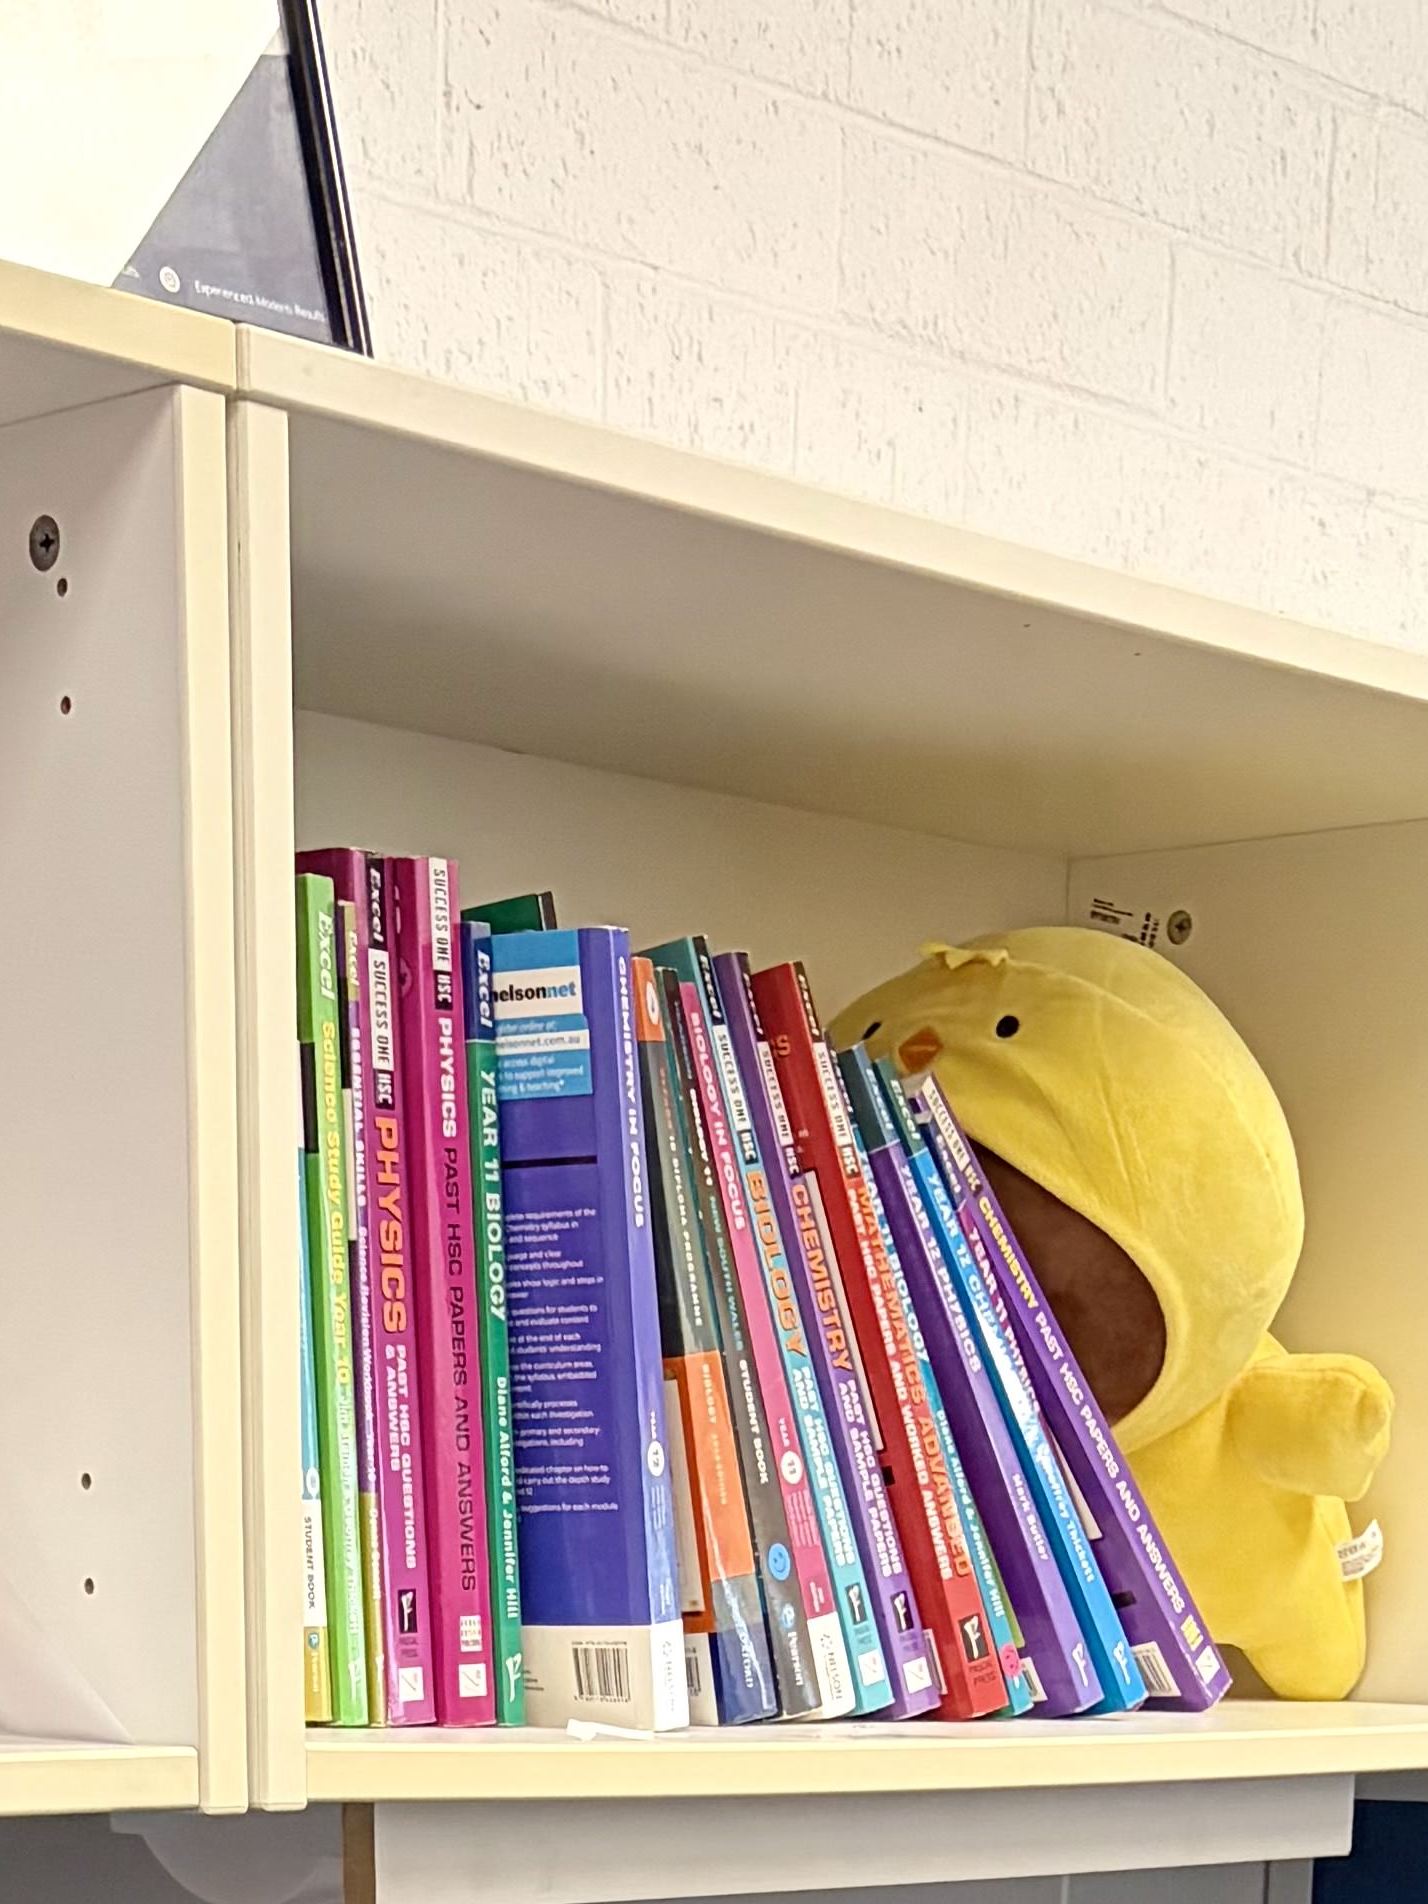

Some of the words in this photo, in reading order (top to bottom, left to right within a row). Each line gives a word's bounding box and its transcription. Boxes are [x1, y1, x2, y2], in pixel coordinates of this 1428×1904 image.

[370, 869, 384, 943] Excel
[433, 869, 448, 937] SUCCESS
[436, 941, 449, 962] ONE
[317, 911, 335, 1000] Excel
[374, 961, 388, 1029] SUCCESS
[477, 950, 493, 1029] Excel
[377, 1034, 390, 1063] ONE
[438, 1017, 456, 1139] PHYSICS
[618, 956, 636, 1102] CHEMISTRY
[480, 1070, 498, 1147] YEAR
[628, 1107, 638, 1136] IN
[690, 1012, 721, 1116] BIOLOGY
[714, 1121, 727, 1146] IN
[721, 1151, 746, 1231] FOCUS
[699, 955, 721, 1019] Excel
[746, 1171, 807, 1357] BIOLOGY
[890, 1080, 921, 1140] Excel
[926, 1173, 958, 1238] YEAR
[443, 1147, 460, 1215] PAST
[630, 1141, 644, 1228] FOCUS
[743, 973, 763, 1035] Excel
[792, 1185, 853, 1372] CHEMISTRY
[866, 1068, 894, 1131] Excel
[901, 1164, 929, 1230] YEAR
[939, 1268, 982, 1374] PHYSICS
[375, 1117, 407, 1334] PHYSICS
[447, 1223, 463, 1276] HSC
[485, 1192, 507, 1322] BIOLOGY
[799, 975, 820, 1036] Excel
[857, 1187, 923, 1407] MATHEMATICS
[918, 1415, 972, 1577] ADVANCED
[396, 1344, 409, 1398] PAST
[449, 1285, 467, 1386] PAPERS
[848, 1188, 866, 1235] PAST
[870, 1284, 897, 1356] PAPERS
[901, 1404, 929, 1486] WORKED
[922, 1490, 953, 1581] ANSWERS
[385, 1366, 401, 1472] ANSWERS
[455, 1397, 471, 1451] AND
[497, 1377, 508, 1427] Diane
[739, 1360, 760, 1432] STUDENT
[753, 1437, 769, 1485] BOOK
[978, 1196, 1039, 1309] CHEMISTRY
[1035, 1311, 1064, 1360] PAST
[1059, 1362, 1084, 1406] HSC
[1080, 1404, 1119, 1479] PAPERS
[1115, 1480, 1141, 1522] AND
[1136, 1524, 1186, 1615] ANSWERS
[400, 1451, 417, 1569] QUESTIONS
[499, 1432, 512, 1487] Alford
[846, 1380, 866, 1424] PAST
[870, 1473, 903, 1575] QUESTIONS
[850, 1427, 872, 1501] SAMPLE
[868, 1507, 891, 1578] PAPERS
[457, 1461, 476, 1591] ANSWERS
[503, 1510, 517, 1584] Jennifer
[506, 1591, 519, 1619] Hill
